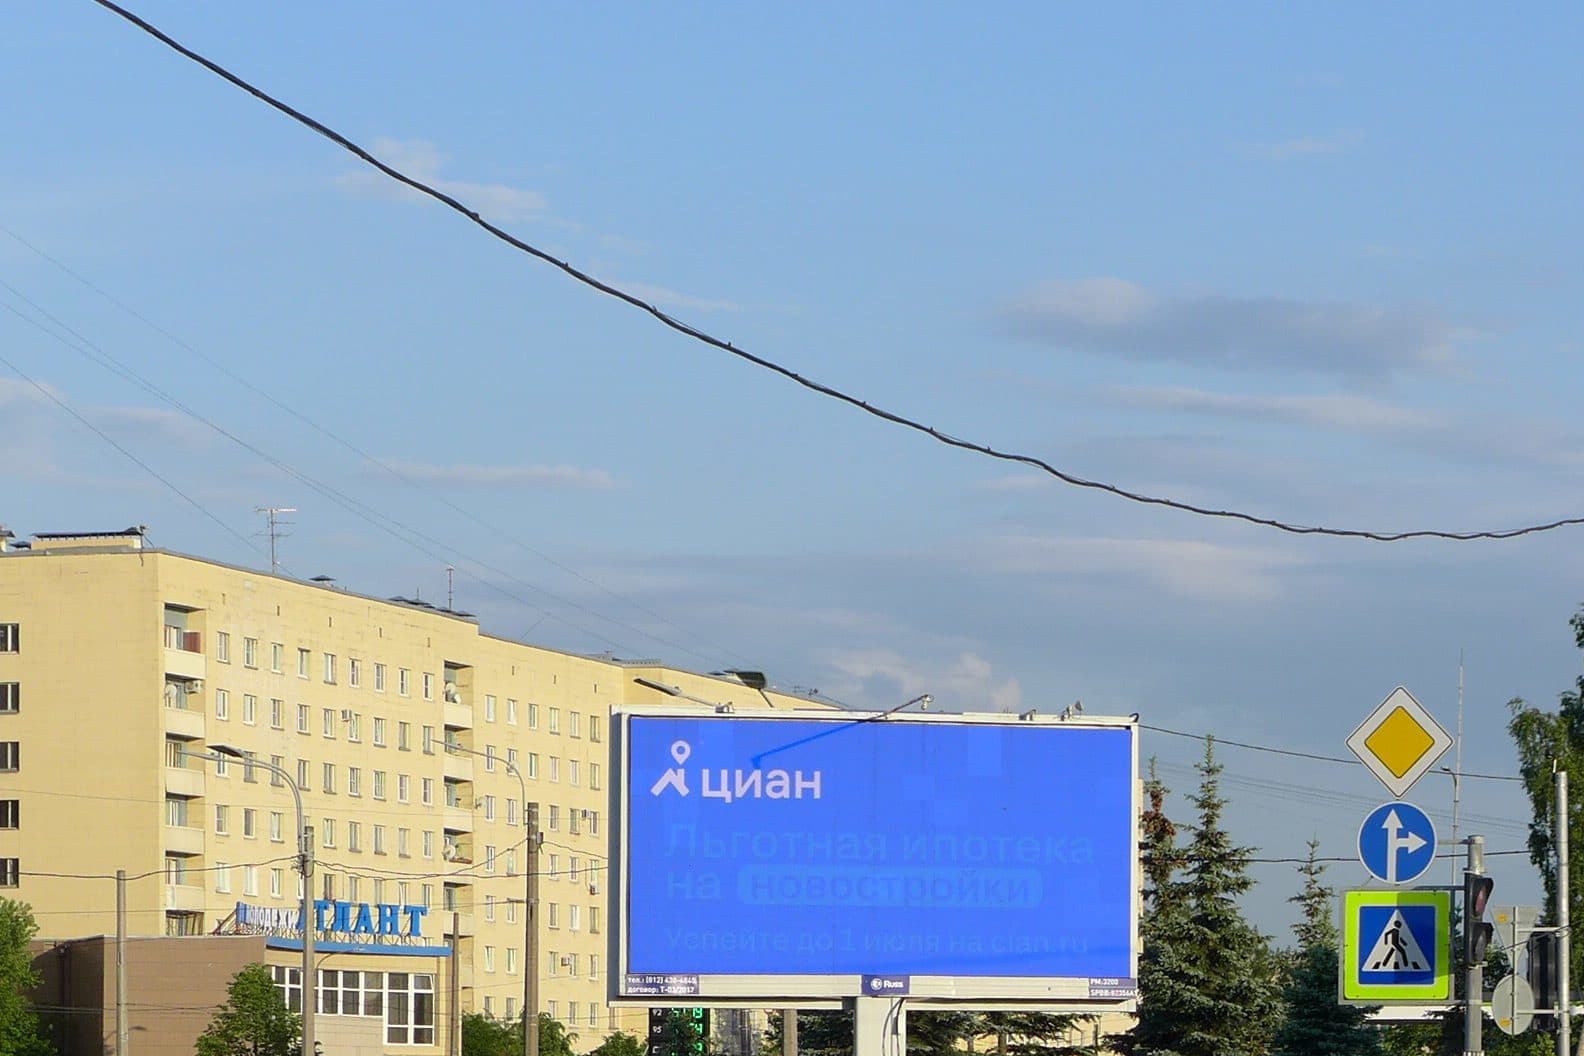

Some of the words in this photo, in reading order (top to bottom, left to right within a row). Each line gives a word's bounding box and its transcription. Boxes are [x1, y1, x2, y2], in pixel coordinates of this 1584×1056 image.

[701, 767, 822, 803] циан
[903, 833, 1097, 864] ипотека
[667, 871, 721, 899] на
[750, 870, 1034, 906] новостройки
